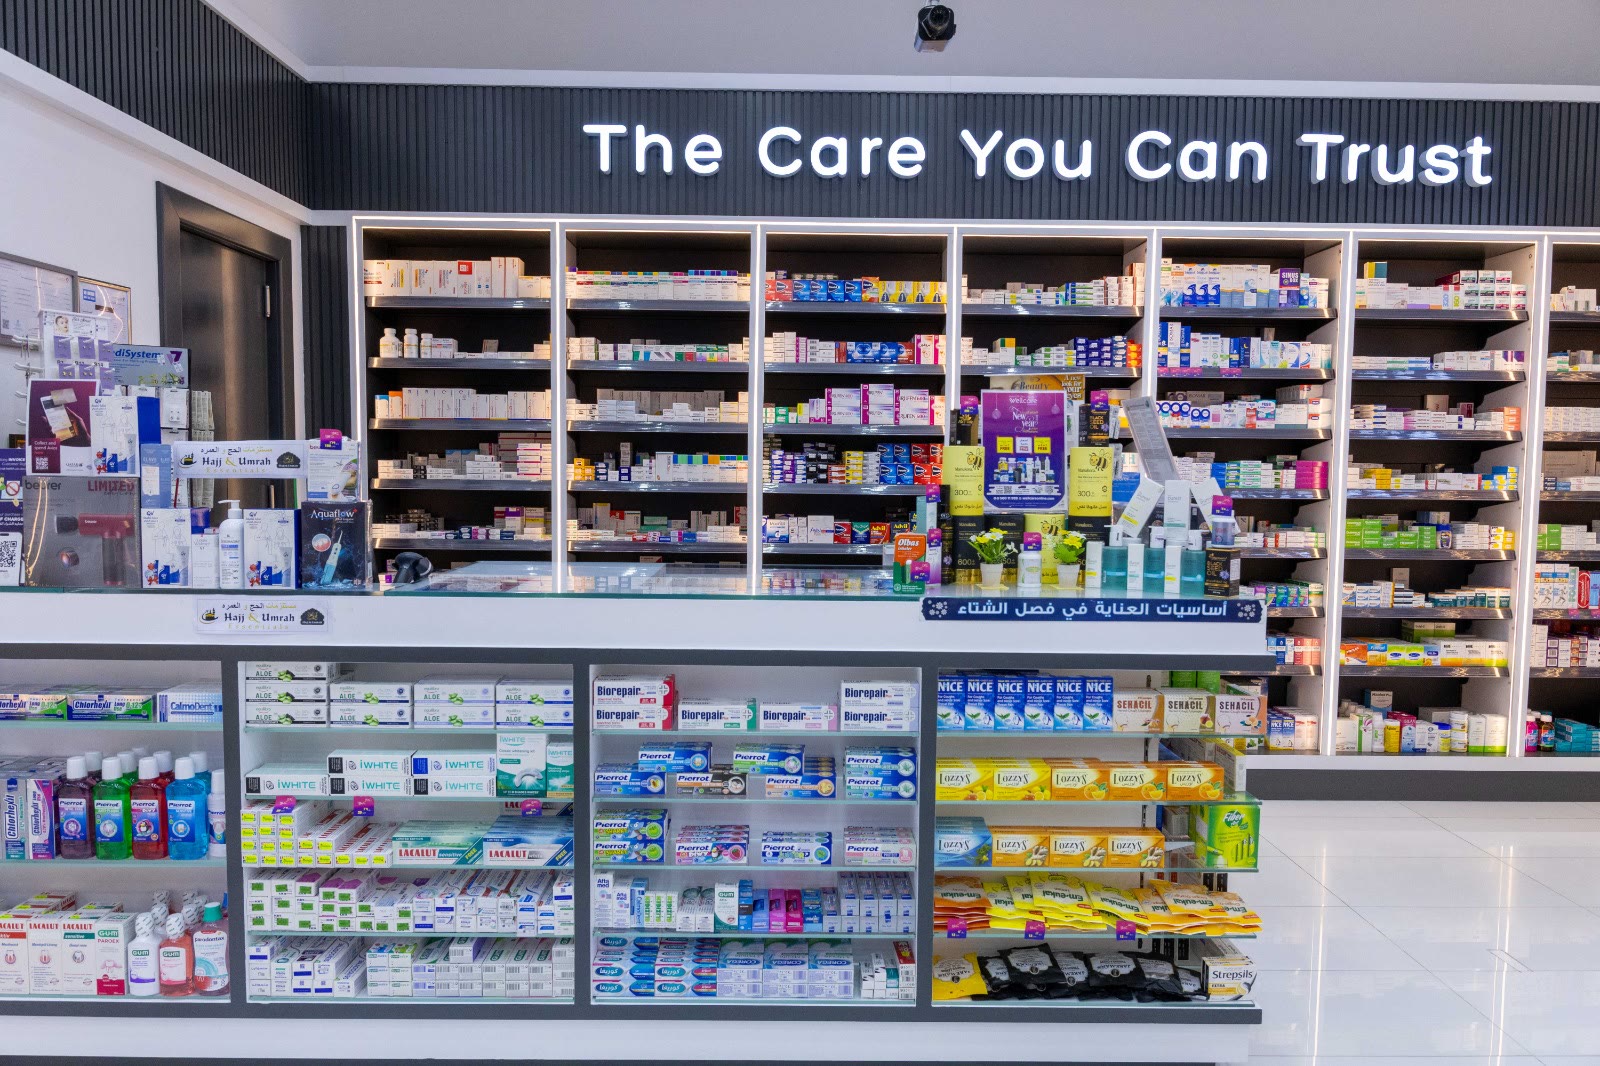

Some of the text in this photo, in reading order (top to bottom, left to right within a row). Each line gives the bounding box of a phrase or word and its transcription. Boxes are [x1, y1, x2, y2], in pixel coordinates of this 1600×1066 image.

[583, 124, 1493, 184] The Care You Can Trust
[202, 456, 223, 467] Hajj
[239, 457, 271, 466] Umrah
[88, 480, 135, 491] LIMITED
[1077, 490, 1091, 498] 300
[310, 509, 355, 519] Aquaflow
[897, 538, 920, 546] Olbas
[957, 599, 1227, 621] أساسيات العناية في فصل الشتاء
[224, 613, 246, 623] Hajj
[261, 613, 295, 622] Umrah
[597, 685, 641, 698] Biorepair
[844, 687, 888, 700] Biorepair
[74, 699, 111, 710] Chlorhexil
[170, 702, 213, 711] CalmoDent
[1117, 700, 1152, 709] SEHACIL
[1168, 700, 1203, 710] SEHACIL
[1219, 701, 1255, 710] SEHACIL
[596, 709, 640, 721] Biorepair
[681, 709, 725, 721] Biorepair
[763, 709, 806, 723] Biorepair
[844, 711, 887, 724] Biorepair
[734, 753, 766, 761] Pierrot
[5, 794, 17, 838] Chlorhexil
[595, 821, 628, 829] Pierrot
[398, 849, 438, 857] LACALUT
[677, 844, 710, 852] Pierrot
[464, 848, 478, 860] FREE
[489, 850, 527, 858] LACALUT
[555, 849, 568, 861] FREE
[1212, 970, 1253, 981] Strepsils
